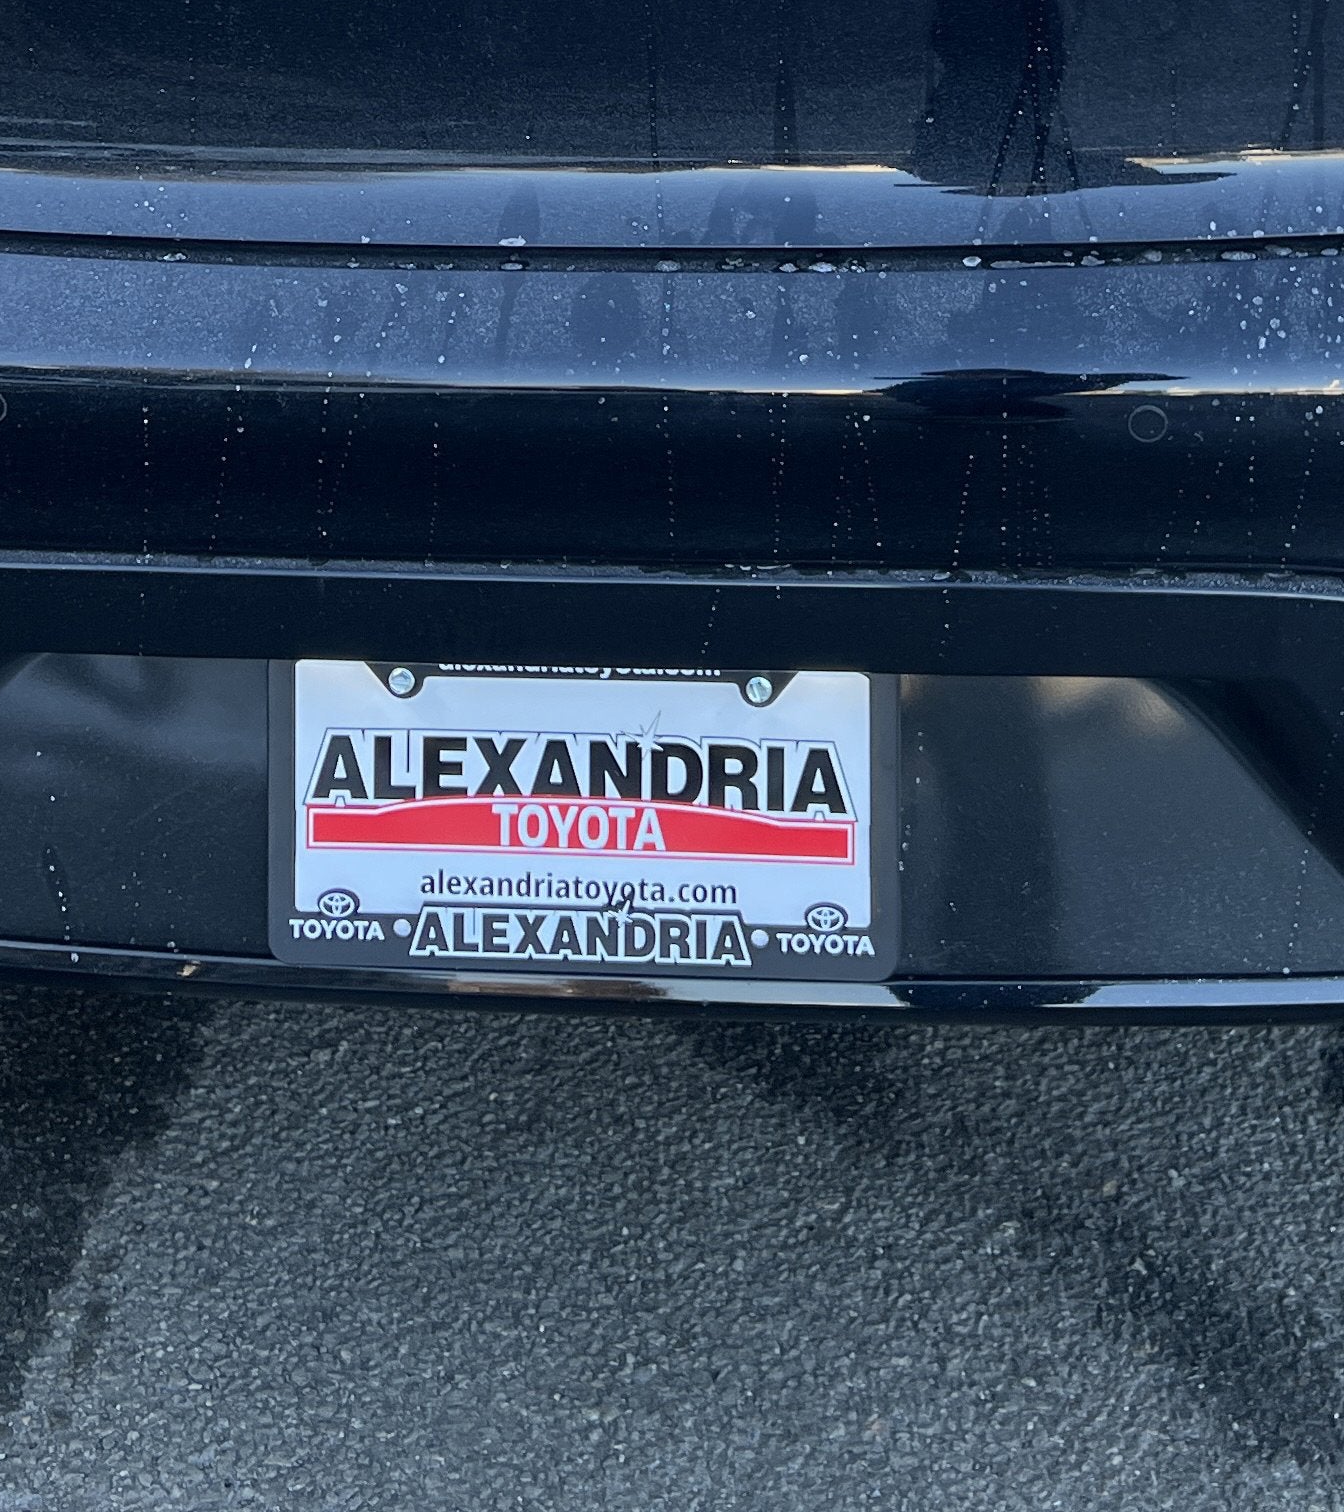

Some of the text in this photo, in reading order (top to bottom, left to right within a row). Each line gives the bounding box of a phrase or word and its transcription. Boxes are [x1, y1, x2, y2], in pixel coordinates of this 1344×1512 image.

[311, 734, 848, 815] ALEXANDRIA
[491, 803, 667, 851] TOYOTA
[419, 868, 737, 905] alexandriatoyota.com
[288, 907, 875, 965] TOYOTA ALEXANDRIA TOYOTA
